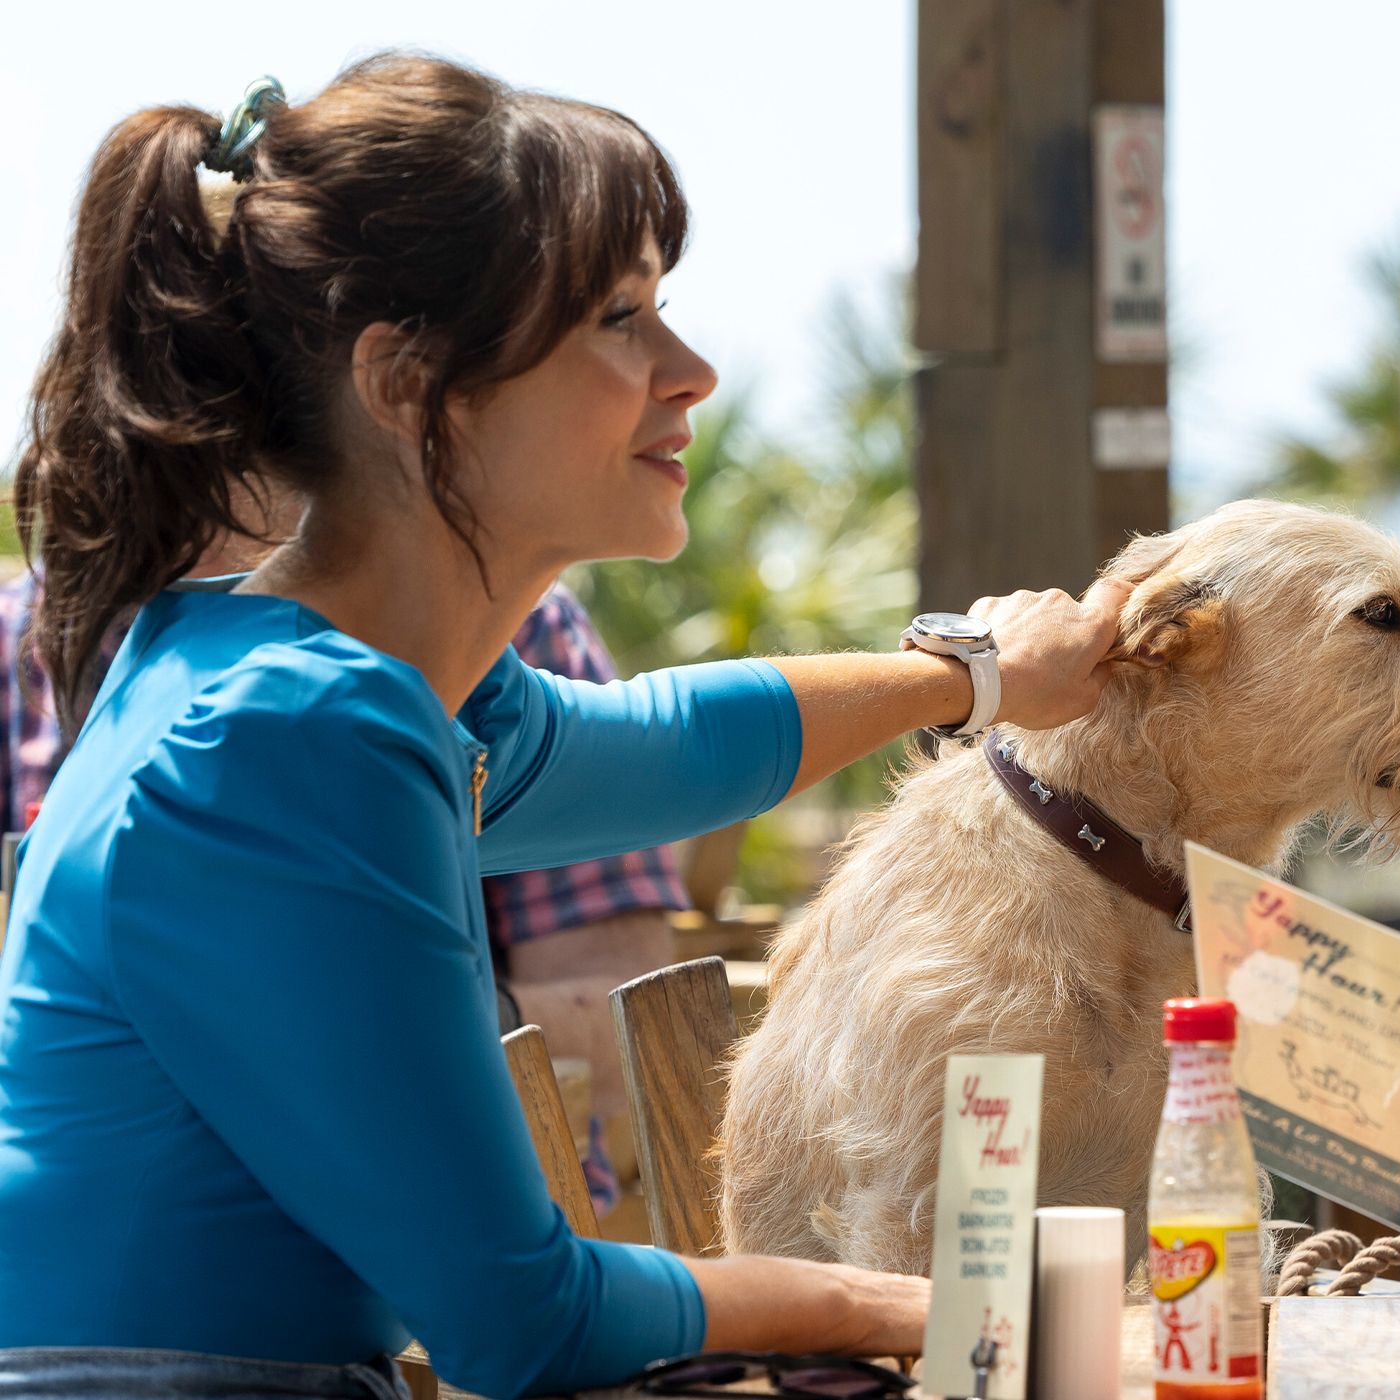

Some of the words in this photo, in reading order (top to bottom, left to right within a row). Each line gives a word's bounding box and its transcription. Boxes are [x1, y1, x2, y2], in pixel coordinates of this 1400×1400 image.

[1252, 888, 1350, 961] Yappy
[958, 1072, 1011, 1131] Yappy
[979, 1126, 1032, 1168] Hour!
